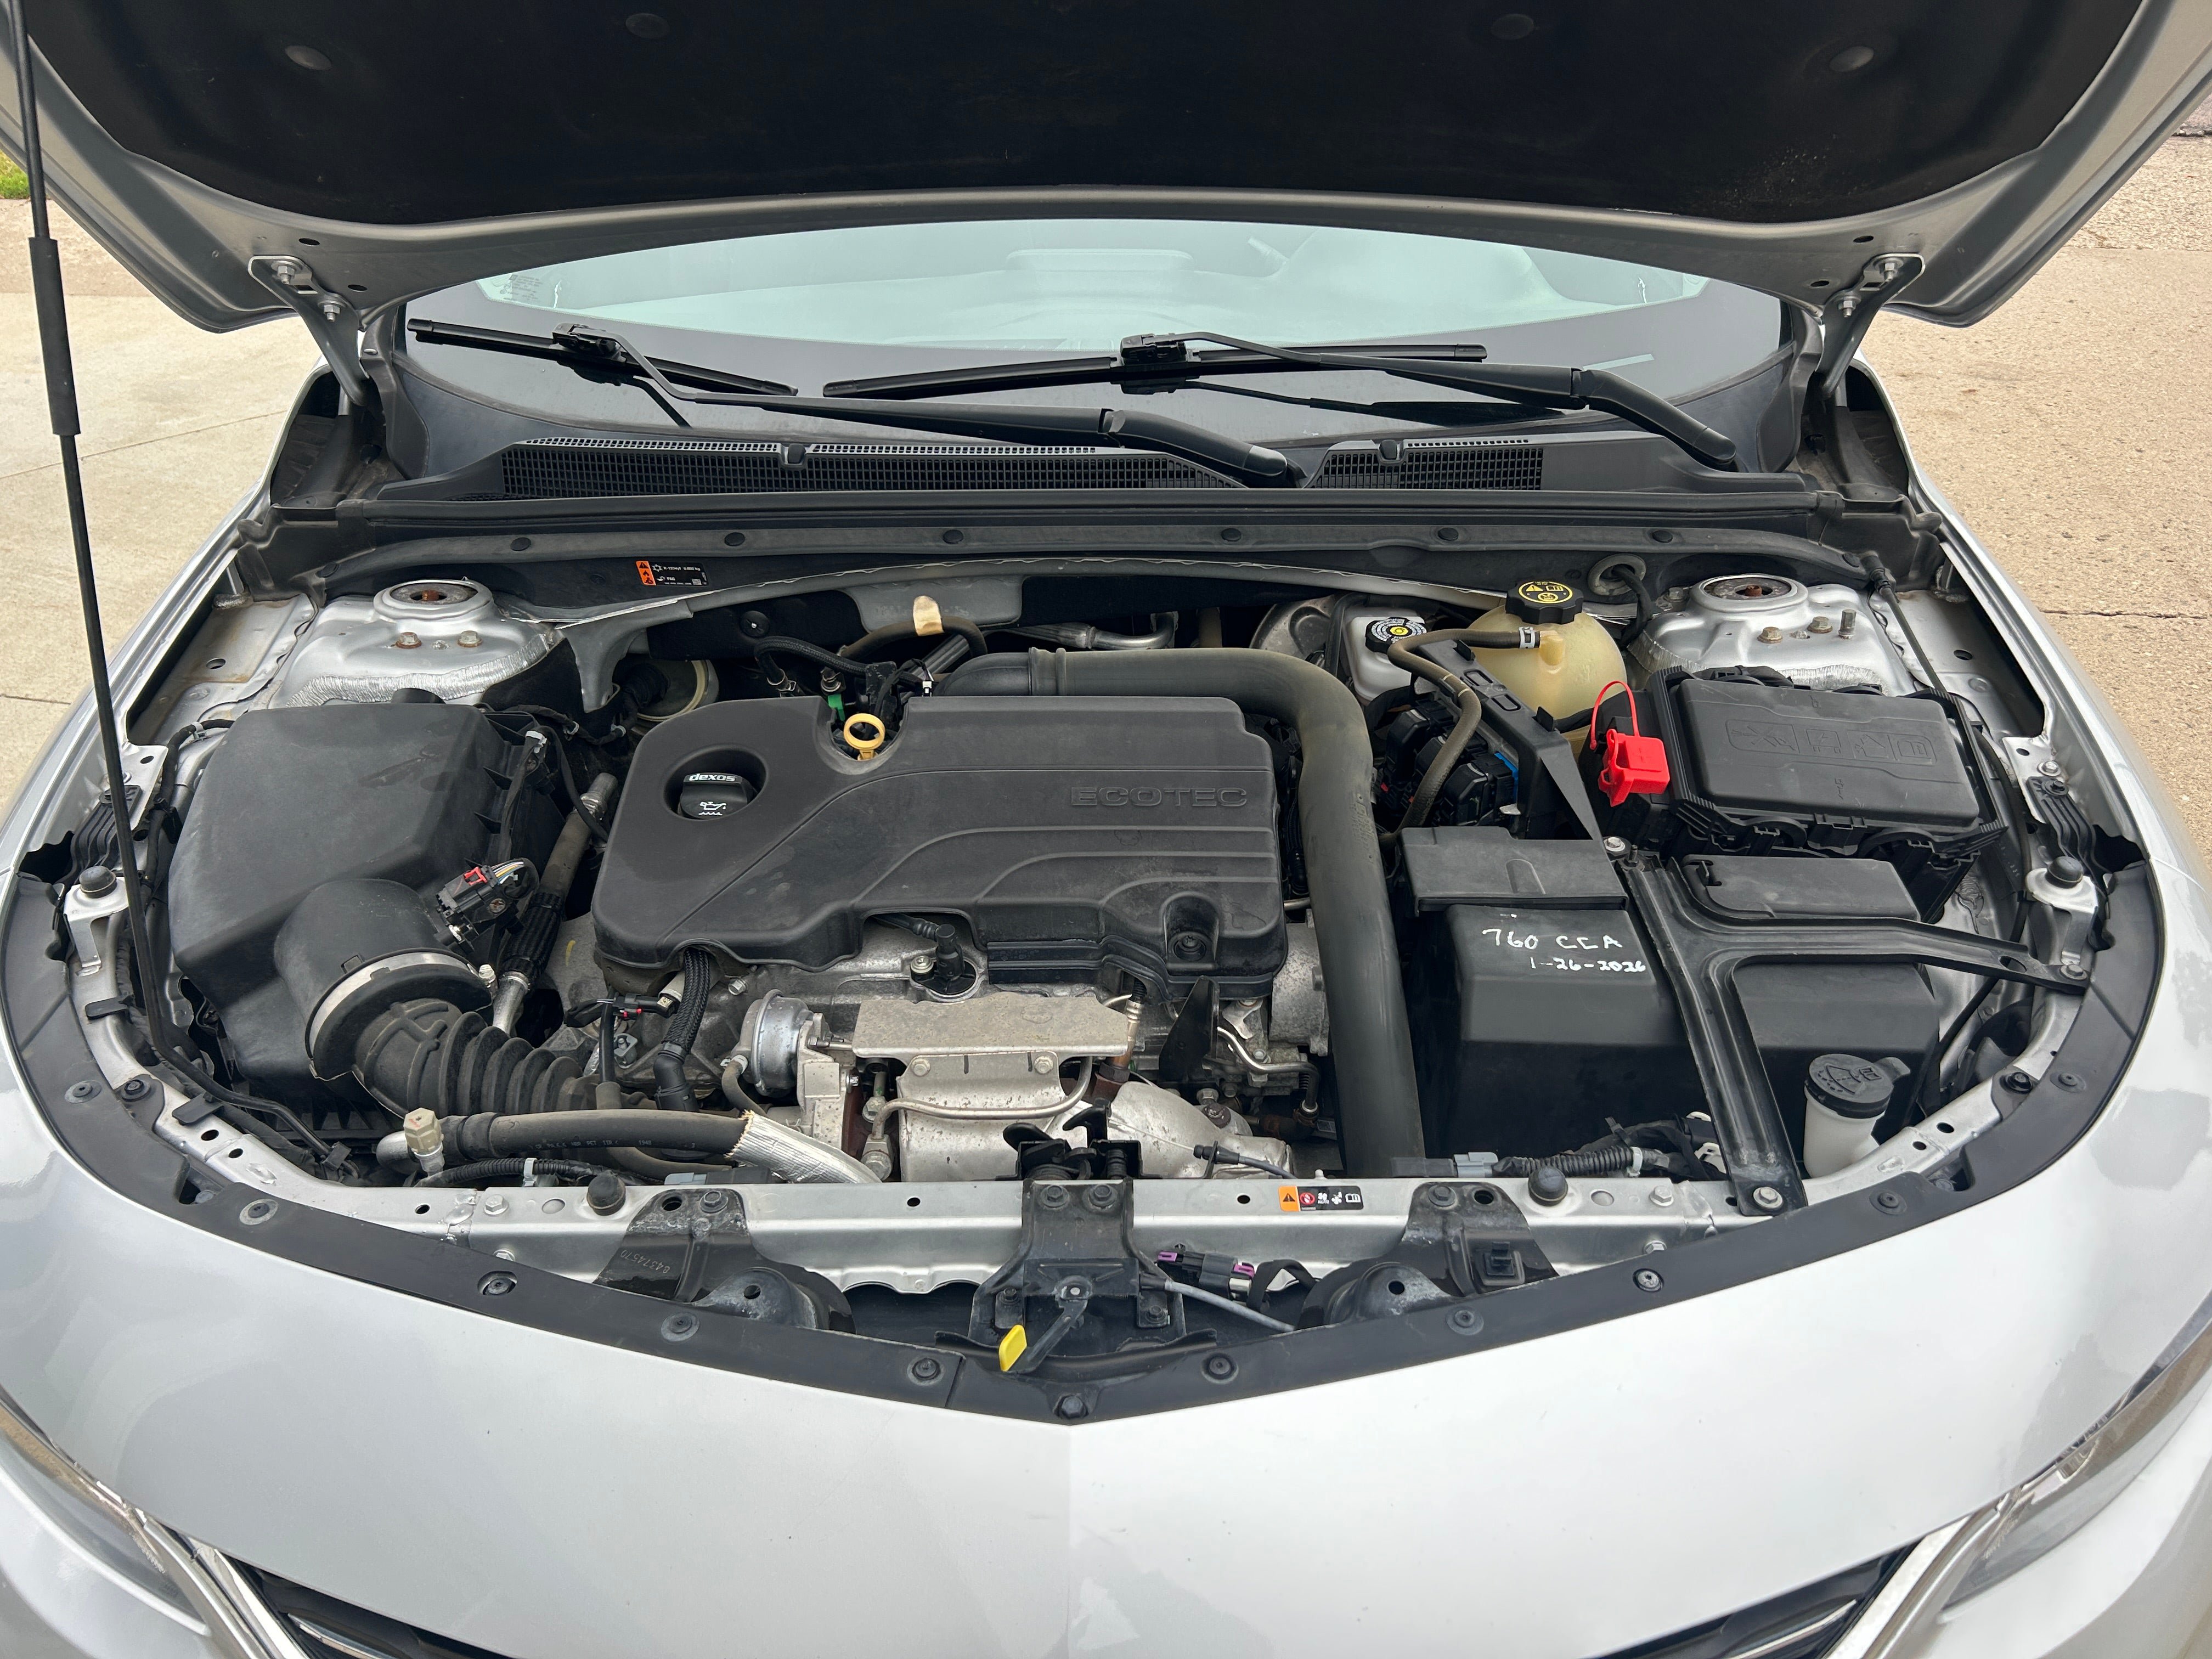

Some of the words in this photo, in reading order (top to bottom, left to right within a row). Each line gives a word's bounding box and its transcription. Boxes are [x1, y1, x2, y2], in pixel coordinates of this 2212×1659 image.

[689, 773, 735, 781] dexos
[1070, 787, 1247, 807] ECOTEC
[1482, 928, 1538, 949] 760
[1556, 935, 1623, 950] CCA
[1530, 956, 1646, 972] 1-26-2026
[620, 1249, 670, 1274] 84374570
